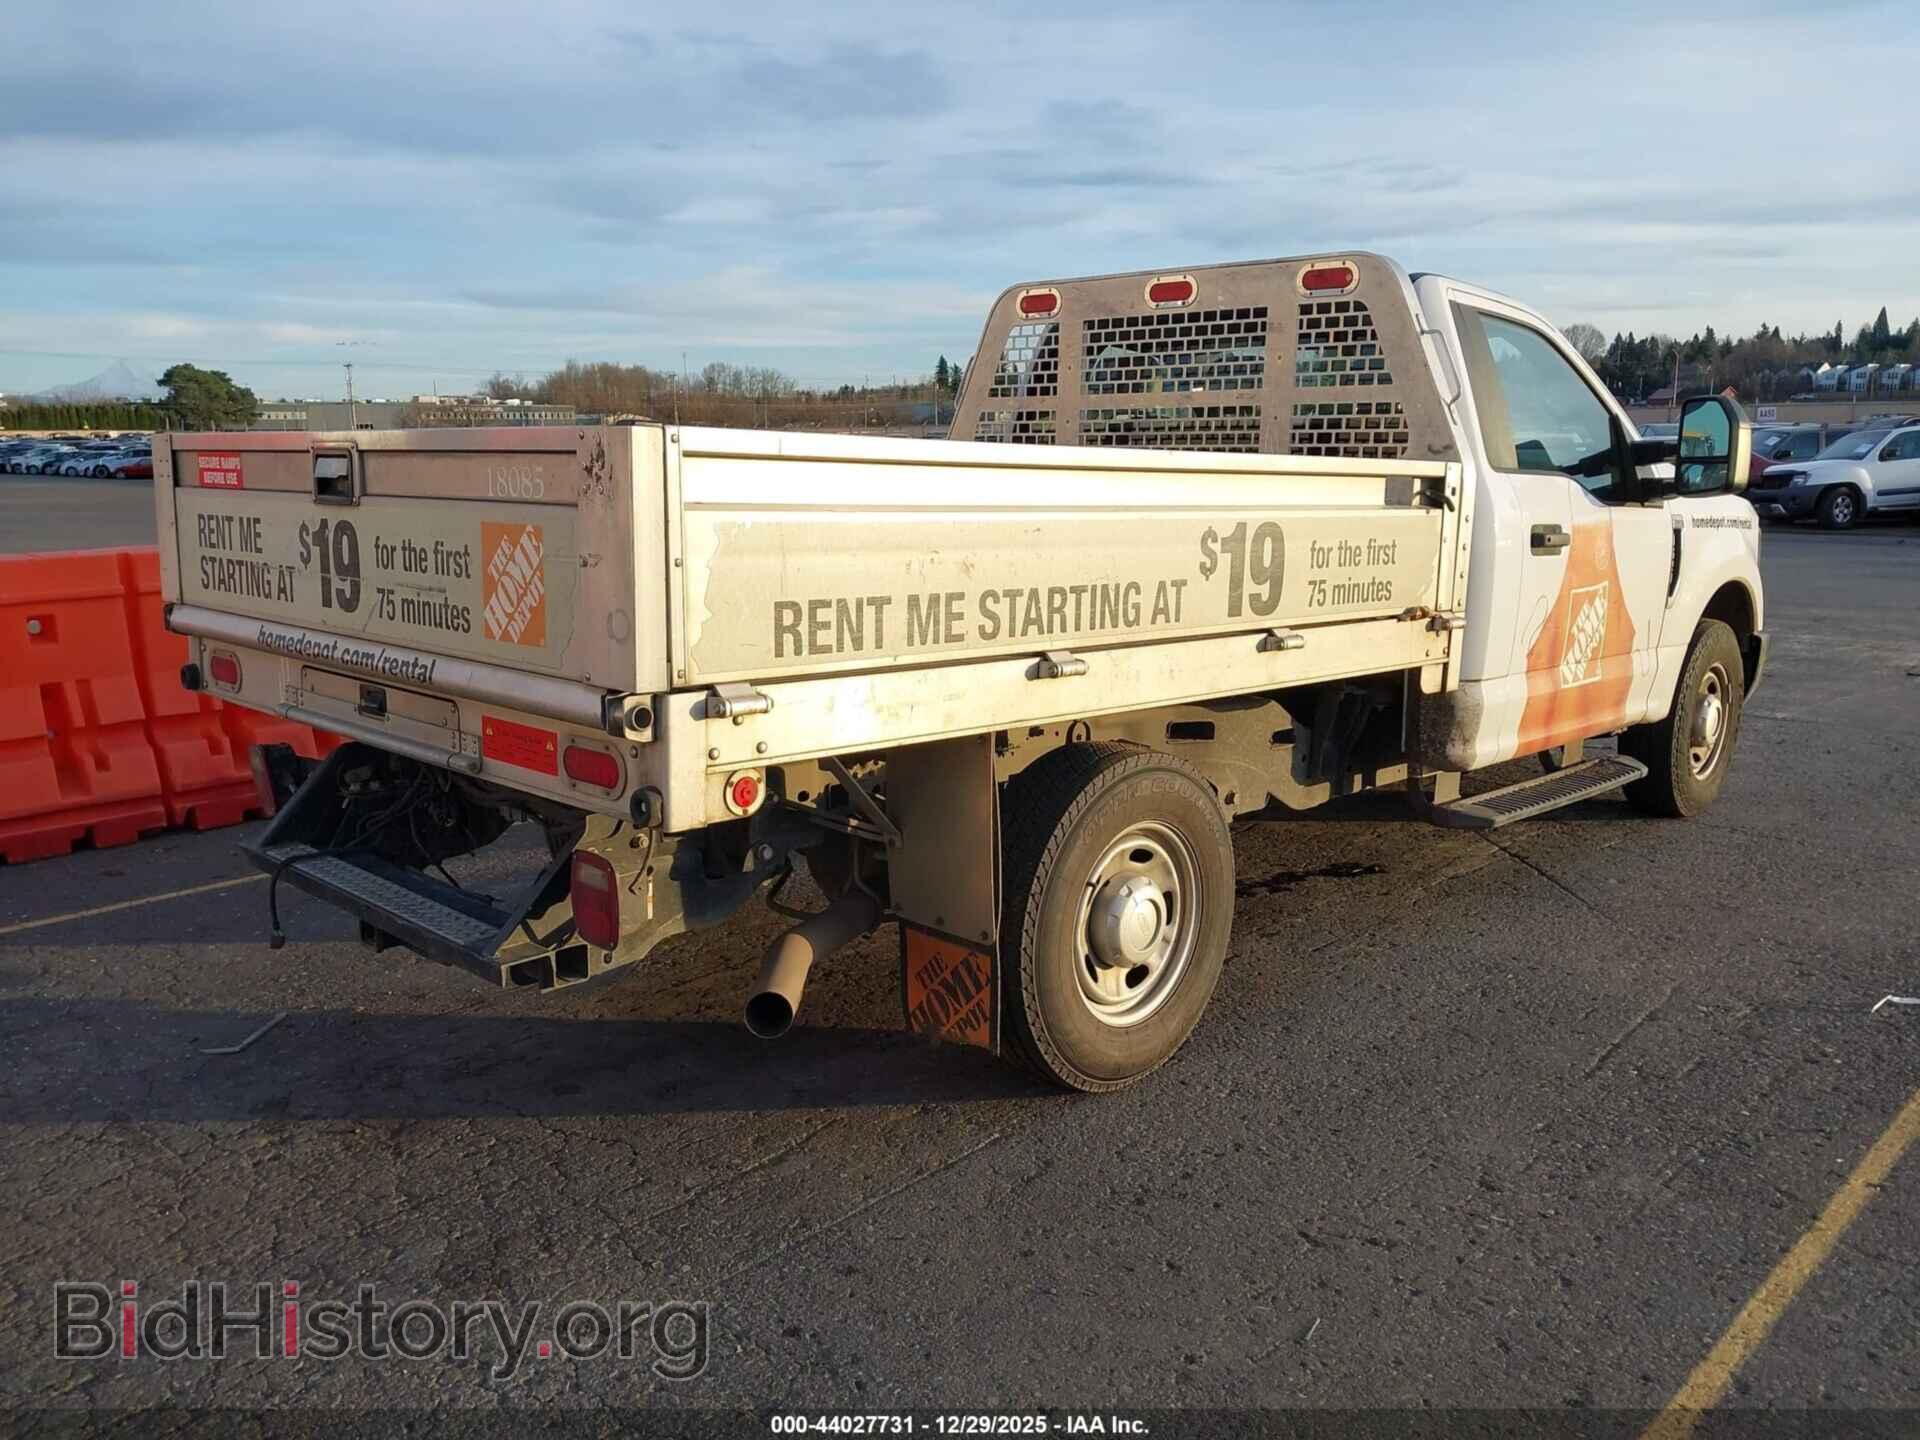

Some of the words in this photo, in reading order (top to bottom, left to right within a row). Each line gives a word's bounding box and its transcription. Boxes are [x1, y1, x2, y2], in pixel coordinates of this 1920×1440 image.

[488, 465, 544, 497] 18085
[198, 513, 234, 551] RENT
[239, 516, 263, 554] ME
[1310, 540, 1334, 569] for
[1337, 539, 1362, 567] the
[1366, 538, 1397, 566] first
[201, 555, 272, 600] STARTING
[277, 564, 296, 602] AT
[299, 518, 361, 613] $19
[374, 536, 397, 570] for
[402, 539, 428, 574] the
[433, 540, 471, 579] first
[488, 534, 514, 581] THE
[484, 524, 544, 641] HOME
[774, 595, 892, 658] RENT
[906, 591, 966, 647] ME
[977, 580, 1142, 641] STARTING
[1150, 578, 1188, 624] AT
[1199, 521, 1286, 618] $19
[1307, 580, 1327, 607] 75
[1331, 576, 1393, 605] minutes
[376, 587, 396, 621] 75
[401, 593, 471, 634] minutes
[507, 571, 544, 644] DEPOT
[257, 623, 436, 684] homedepot.com/rental
